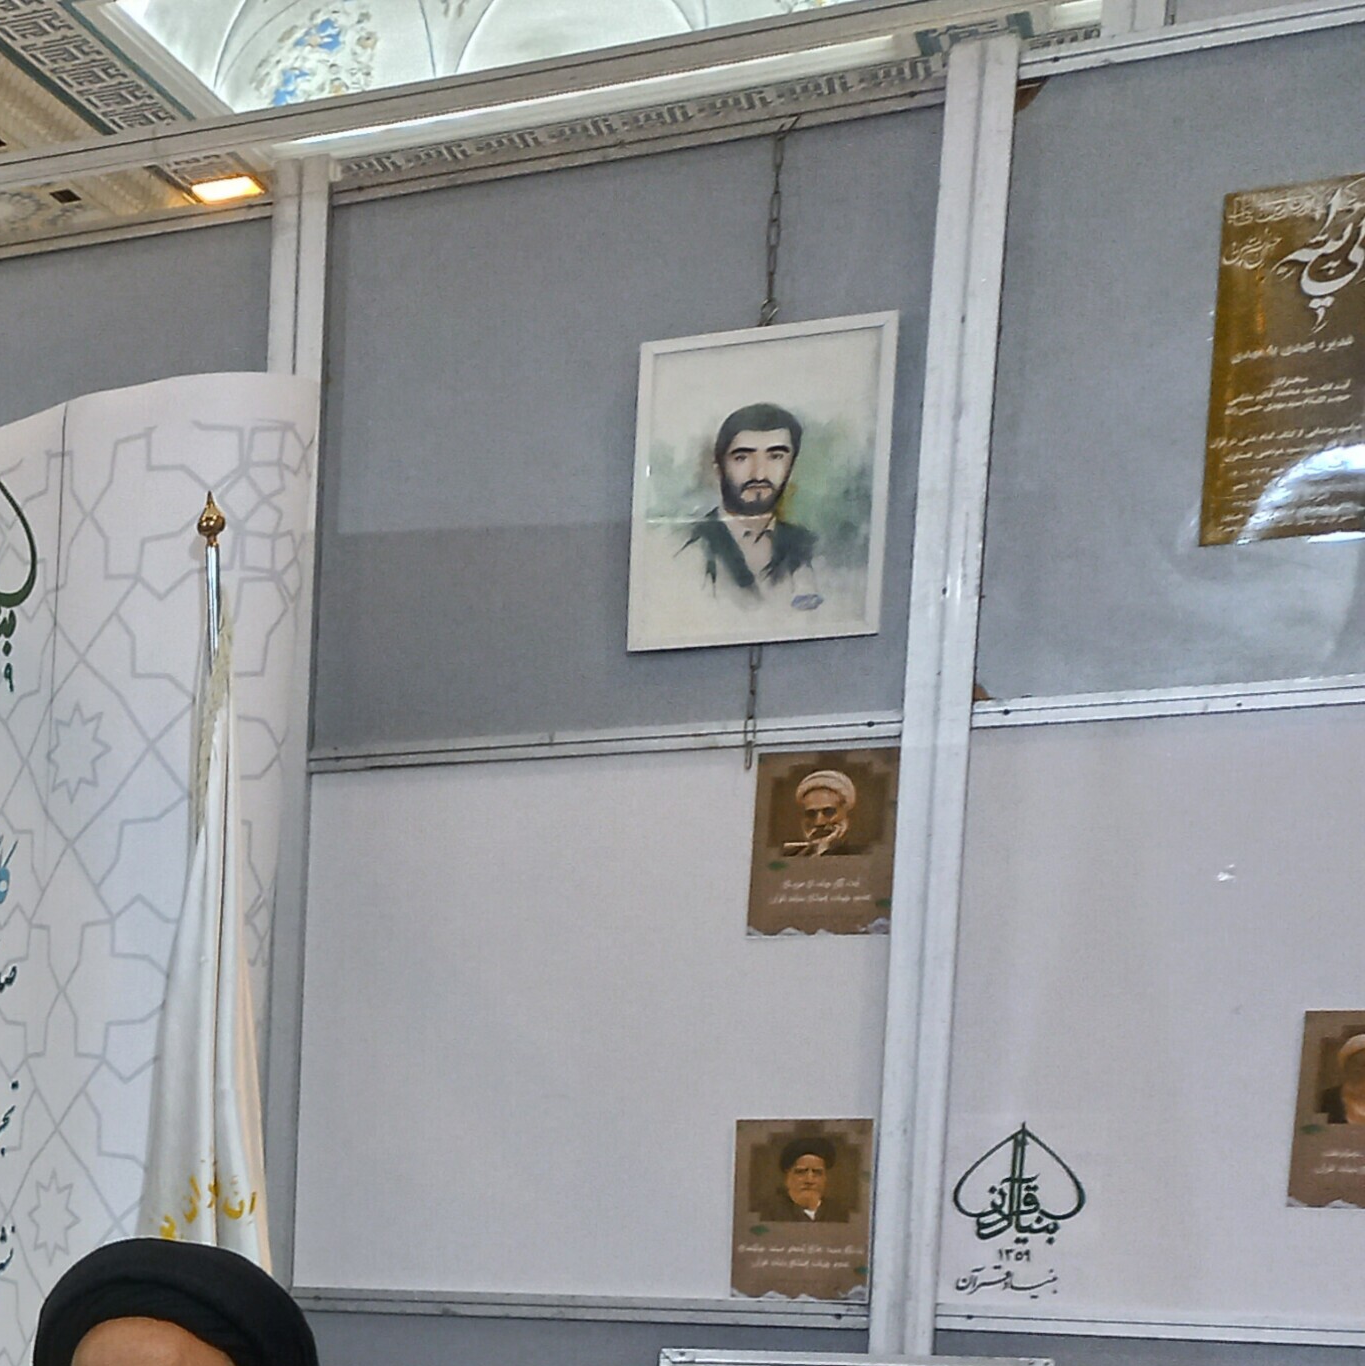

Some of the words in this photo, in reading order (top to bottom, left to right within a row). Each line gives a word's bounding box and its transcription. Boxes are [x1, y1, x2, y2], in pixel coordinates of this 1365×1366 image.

[998, 1248, 1032, 1262] ۱۳۵۹
[956, 1264, 1014, 1296] قرآن
[1001, 1268, 1059, 1300] بنیاد
